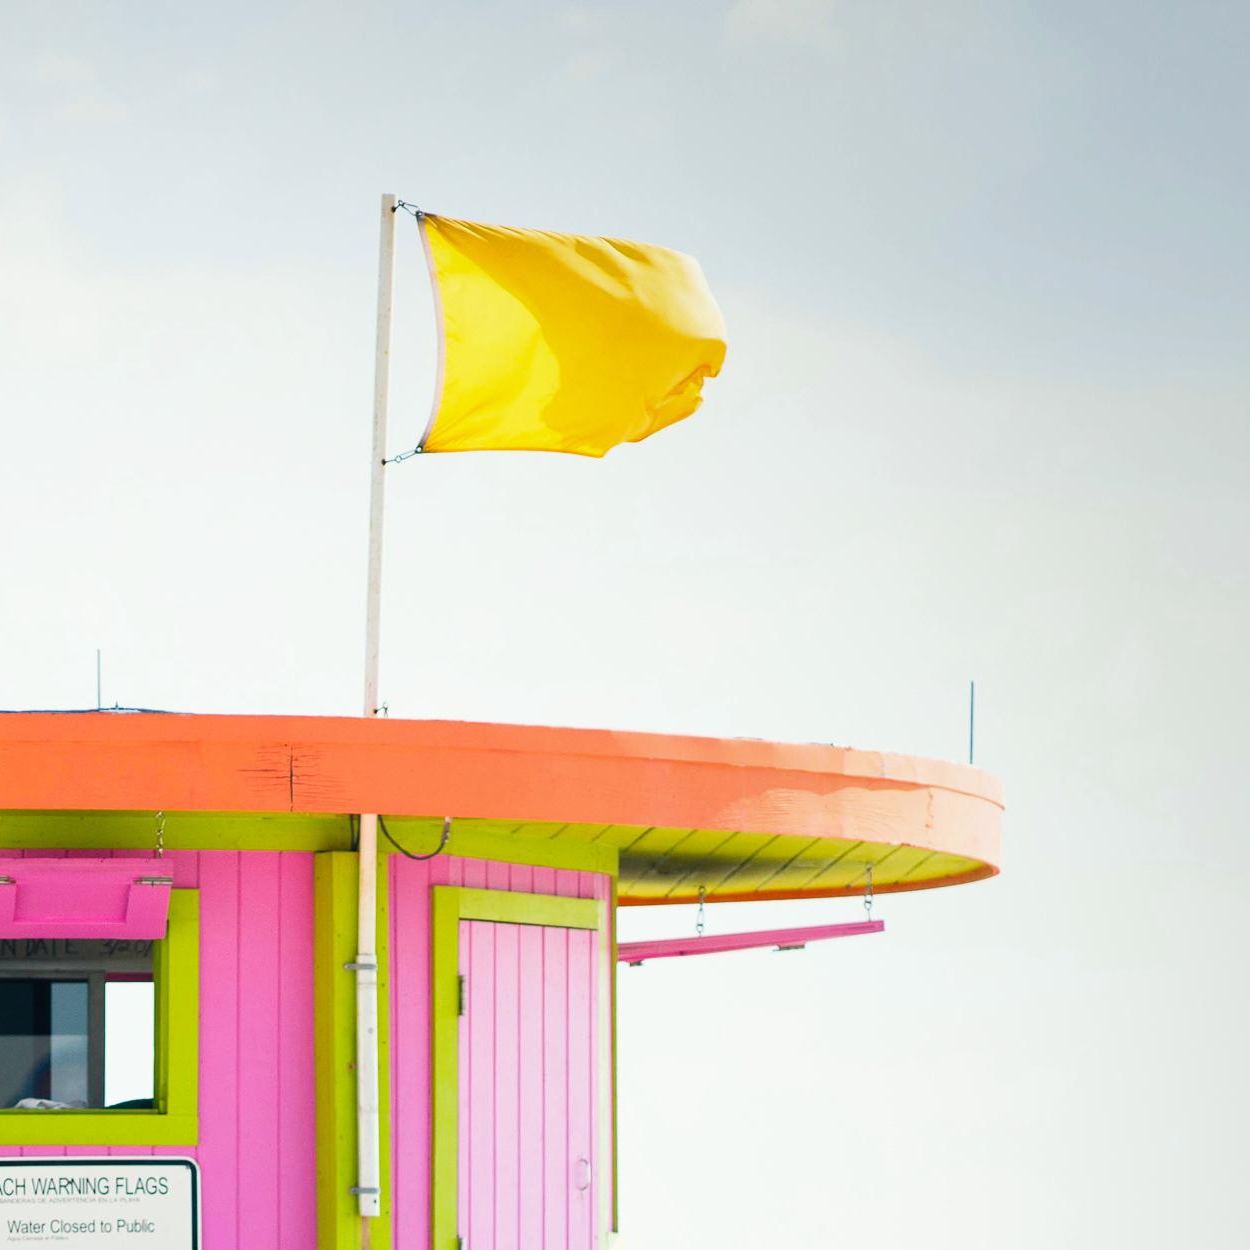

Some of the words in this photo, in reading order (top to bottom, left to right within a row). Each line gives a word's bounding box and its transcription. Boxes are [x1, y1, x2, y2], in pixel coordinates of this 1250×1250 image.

[31, 1177, 110, 1195] WARNING
[115, 1177, 169, 1195] FLAGS
[7, 1220, 45, 1234] Water
[50, 1219, 95, 1233] Closed
[100, 1220, 112, 1233] to
[117, 1219, 155, 1233] Public
